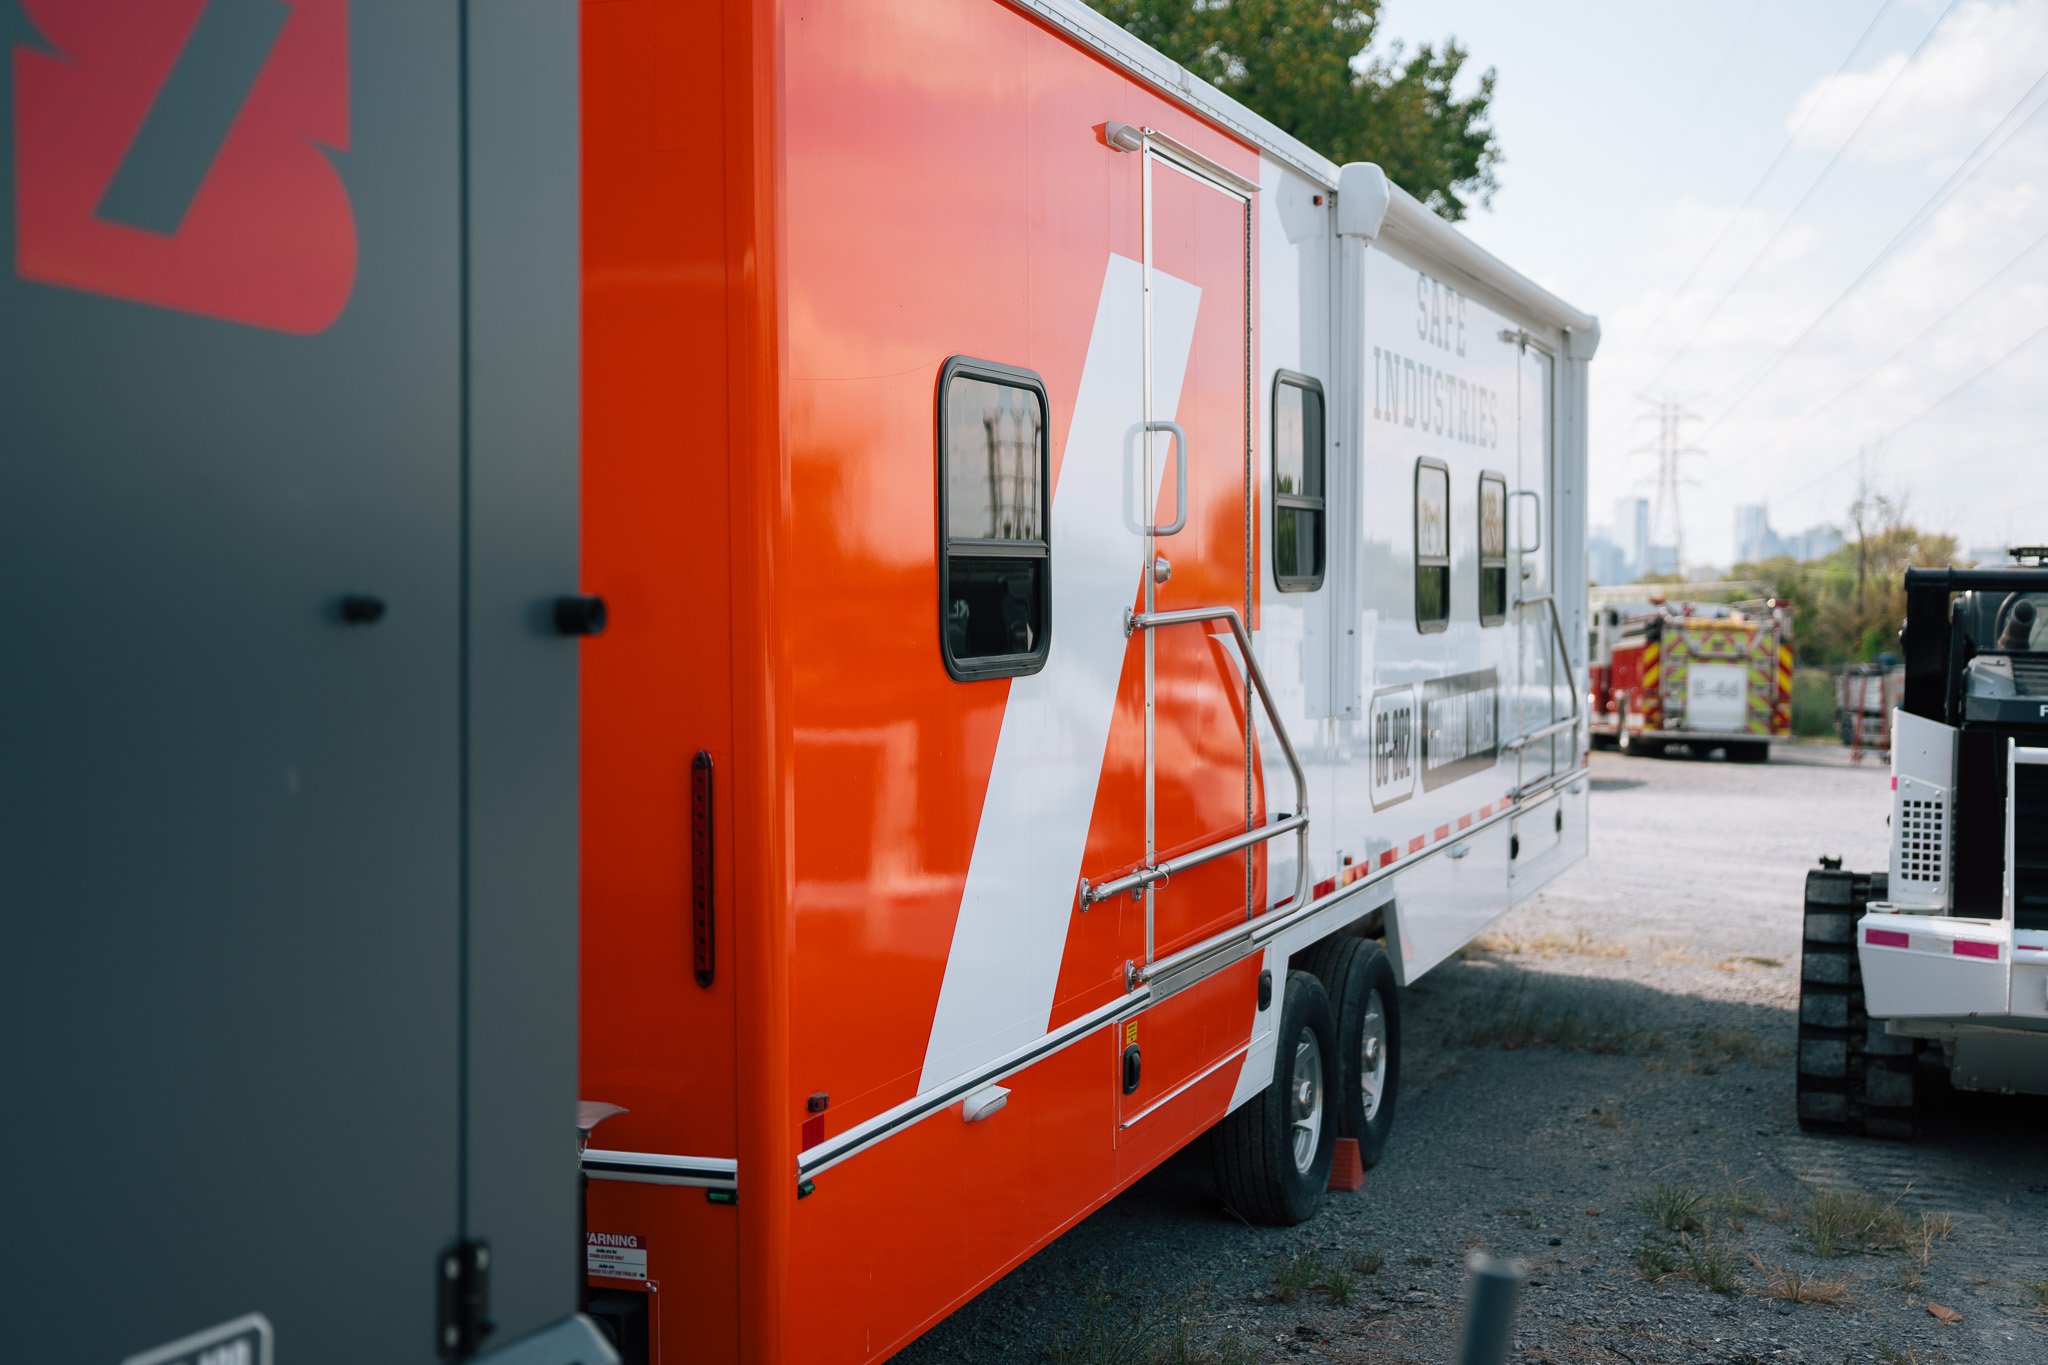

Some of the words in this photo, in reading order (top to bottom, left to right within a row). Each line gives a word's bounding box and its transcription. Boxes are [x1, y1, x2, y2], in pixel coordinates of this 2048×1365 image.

[1417, 271, 1467, 359] SAFE
[1373, 345, 1499, 451] INDUSTRIES
[587, 1232, 637, 1247] ARNING
